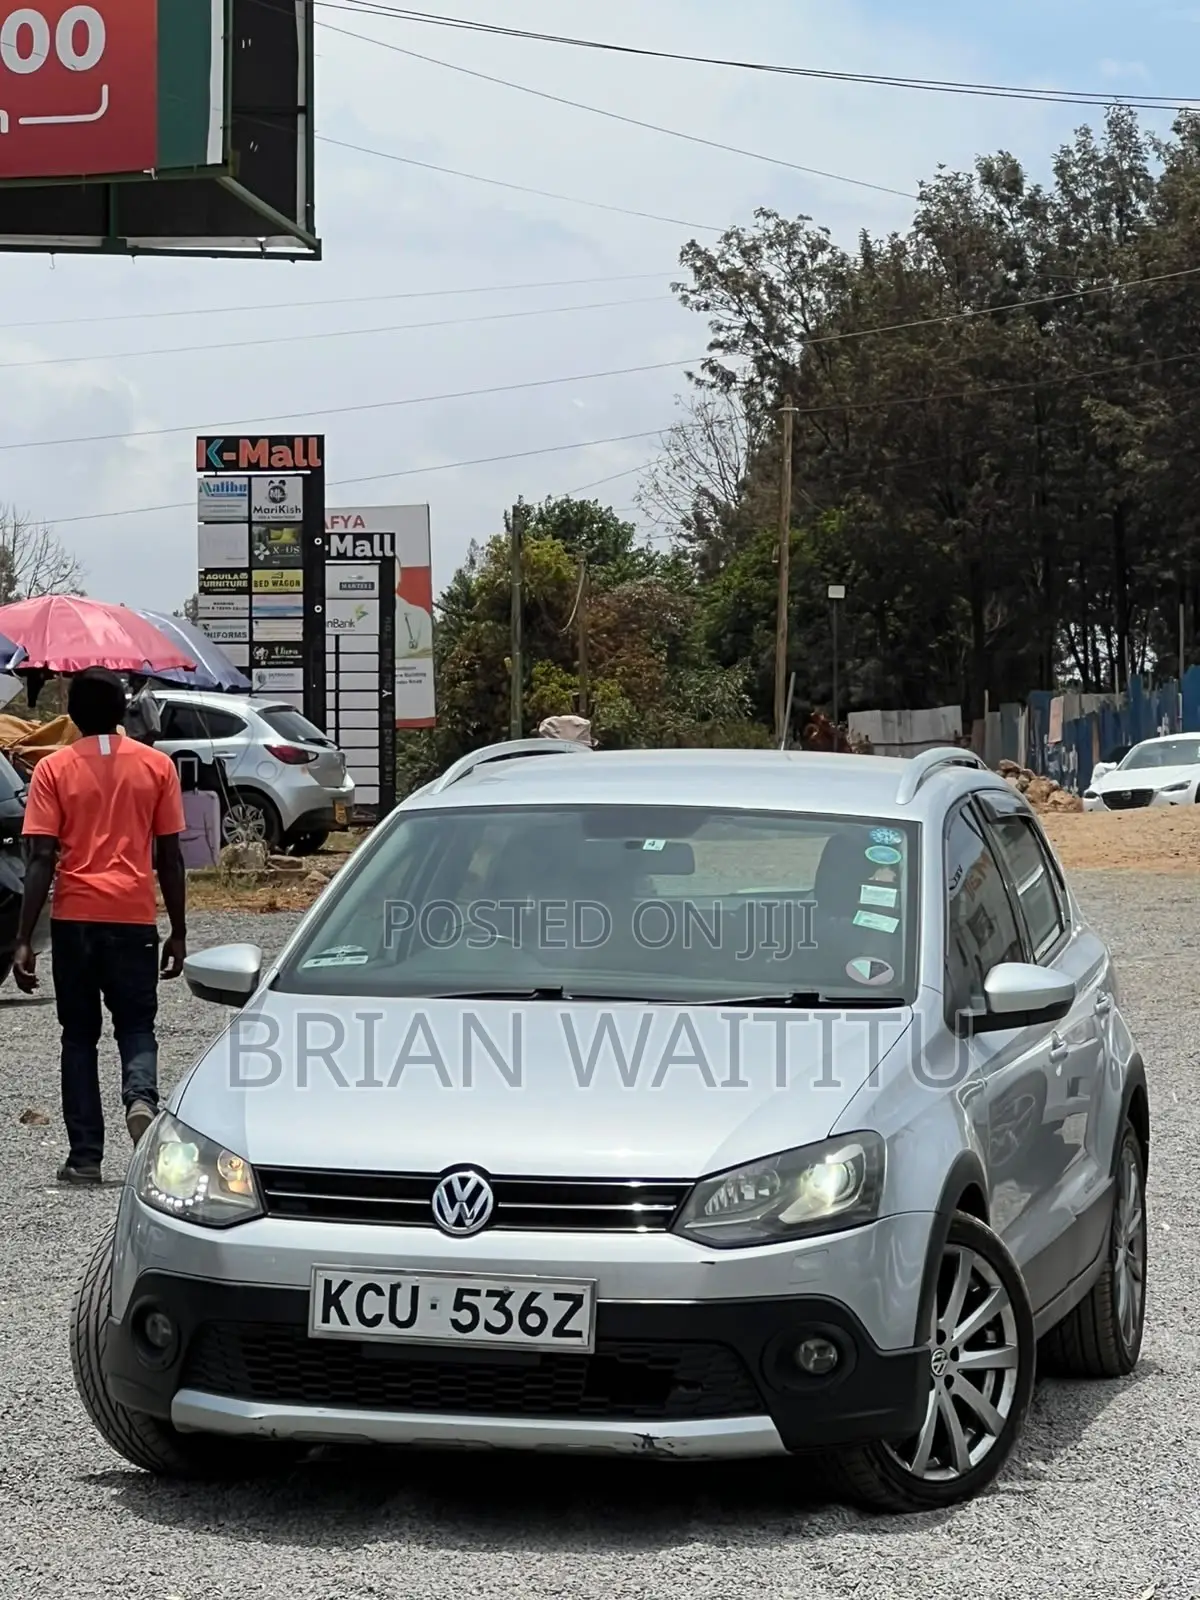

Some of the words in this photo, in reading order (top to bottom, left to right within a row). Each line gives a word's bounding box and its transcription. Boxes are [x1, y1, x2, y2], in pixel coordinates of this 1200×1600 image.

[197, 437, 322, 468] K-Mall
[253, 505, 302, 515] MariKish
[199, 580, 249, 588] FURNITURE
[253, 579, 270, 588] BED
[272, 579, 301, 588] WAGON
[321, 1278, 420, 1328] KCU
[449, 1287, 585, 1338] 536Z
